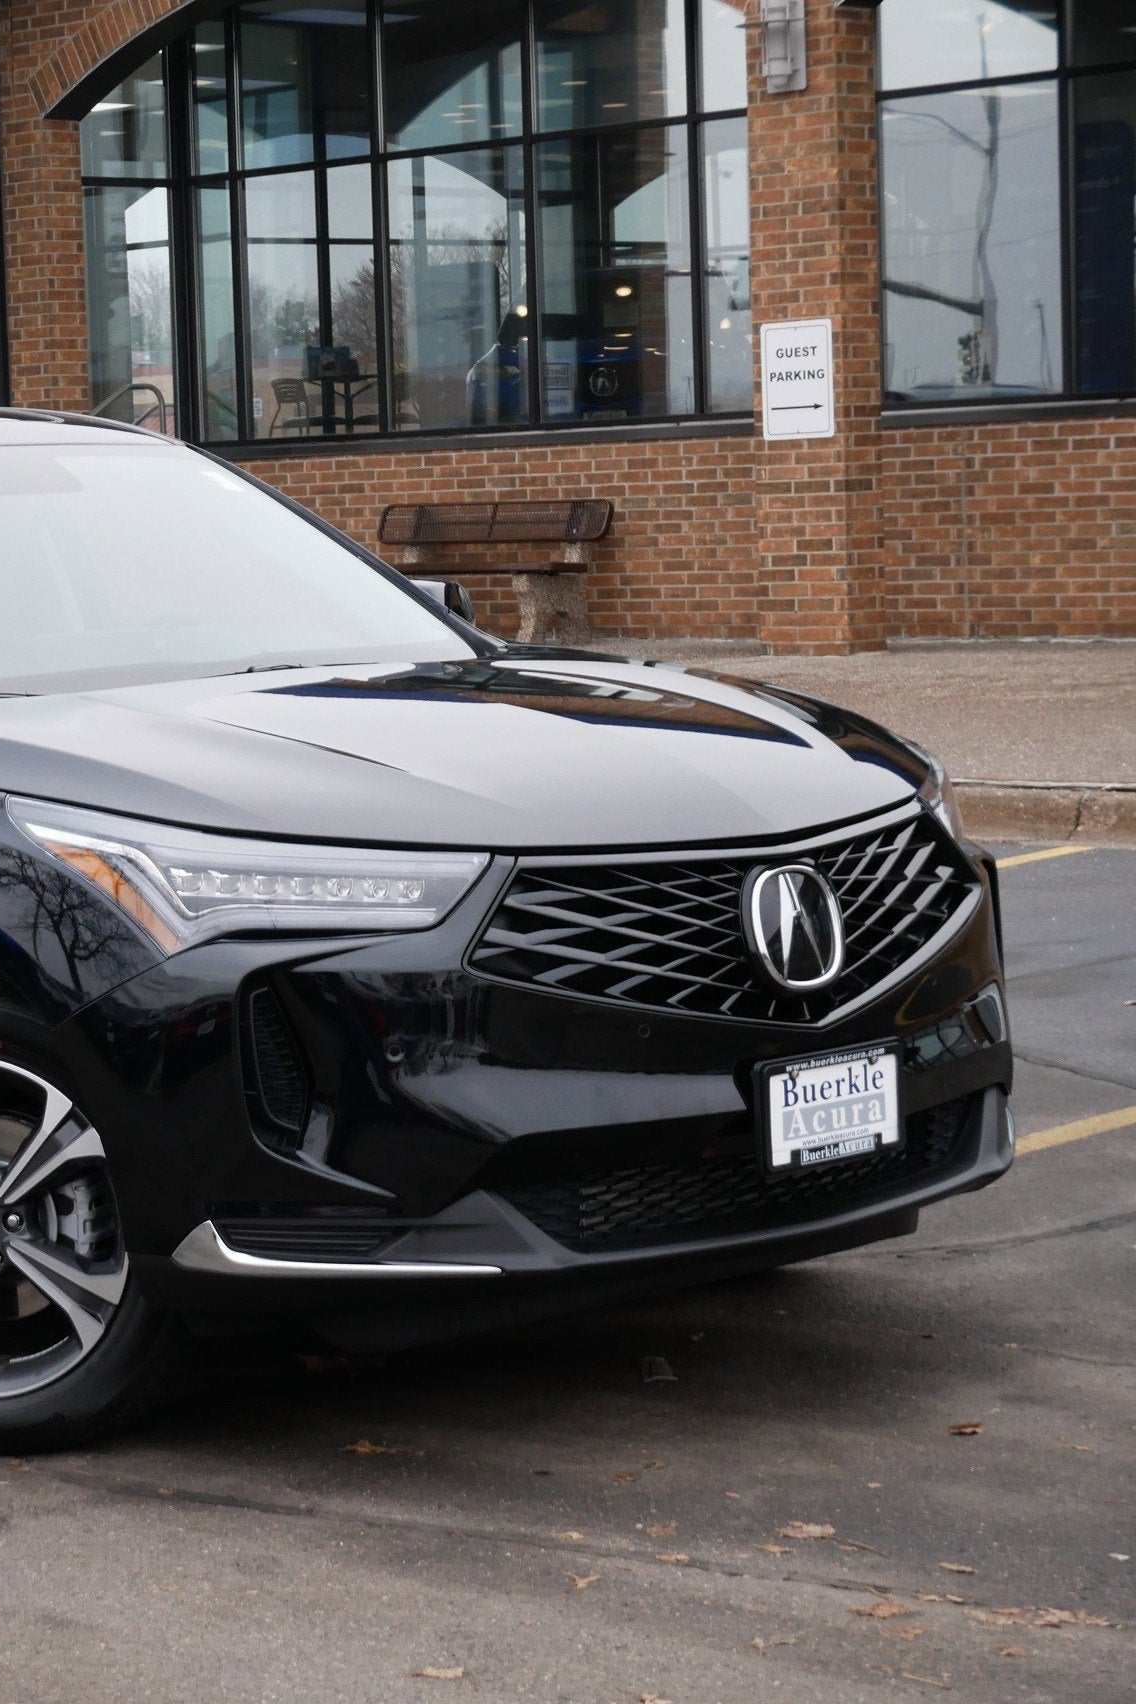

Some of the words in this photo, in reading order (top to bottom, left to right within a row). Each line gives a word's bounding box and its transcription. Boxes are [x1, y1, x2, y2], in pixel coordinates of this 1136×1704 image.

[776, 346, 818, 359] GUEST
[770, 369, 825, 382] PARKING
[785, 1047, 885, 1073] www.buerkleacura.com
[781, 1063, 884, 1108] Buerkle
[787, 1099, 883, 1139] Acura
